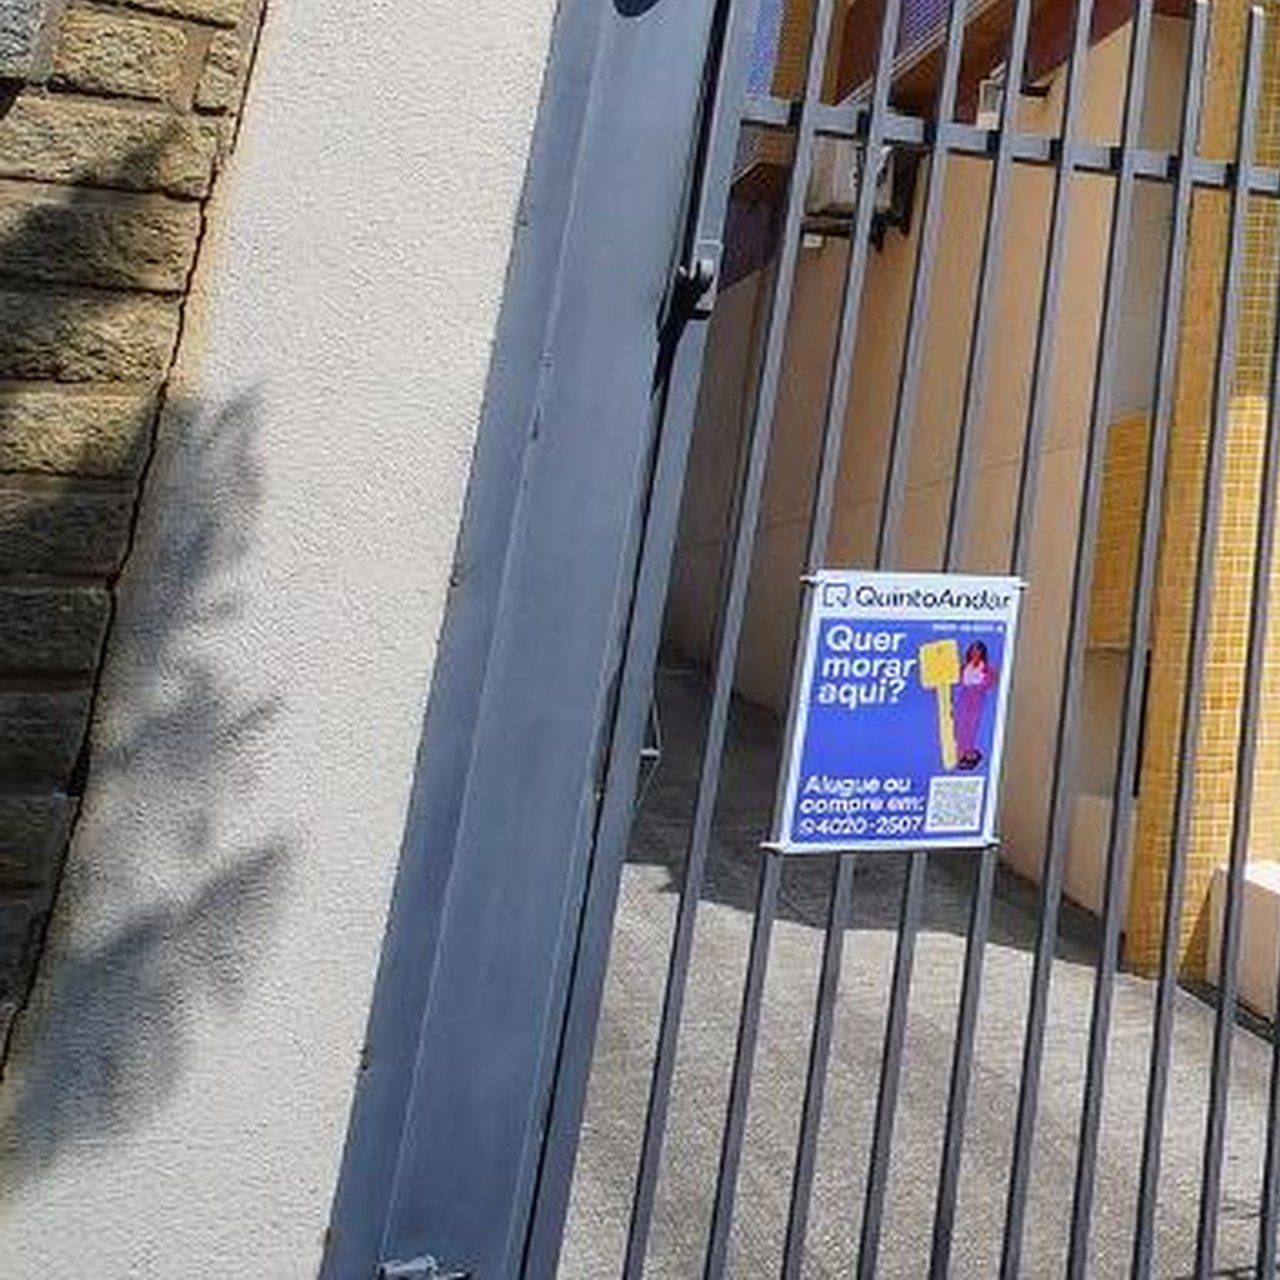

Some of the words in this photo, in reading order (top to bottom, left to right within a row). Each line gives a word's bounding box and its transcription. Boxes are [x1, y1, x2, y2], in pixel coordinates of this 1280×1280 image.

[855, 586, 1011, 610] QuintoAndar
[826, 624, 906, 652] Quer
[822, 657, 917, 678] morar
[818, 677, 906, 710] aqui?
[803, 775, 880, 797] Alugue
[883, 778, 912, 793] ou
[800, 799, 884, 816] compre
